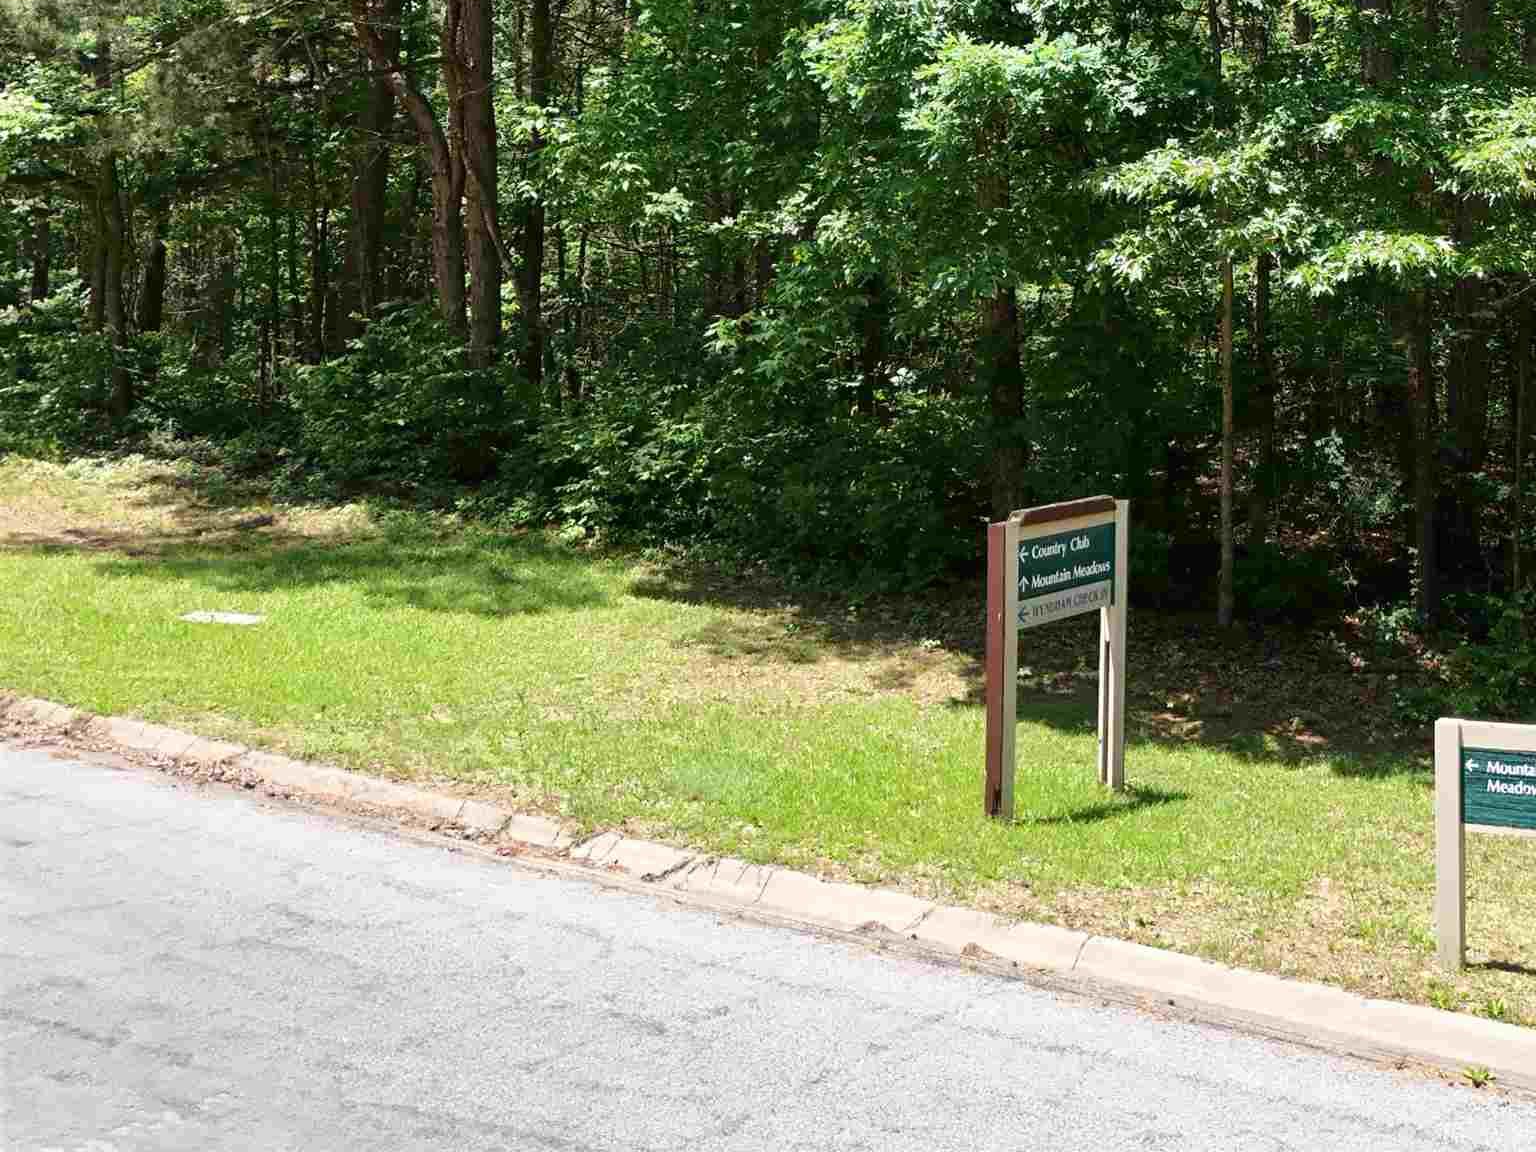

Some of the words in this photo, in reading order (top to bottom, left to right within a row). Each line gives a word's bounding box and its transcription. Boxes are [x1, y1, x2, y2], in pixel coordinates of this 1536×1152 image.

[1031, 542, 1067, 559] Country
[1070, 536, 1090, 551] Club
[1031, 568, 1072, 588] Mountain
[1073, 561, 1111, 578] Meadows
